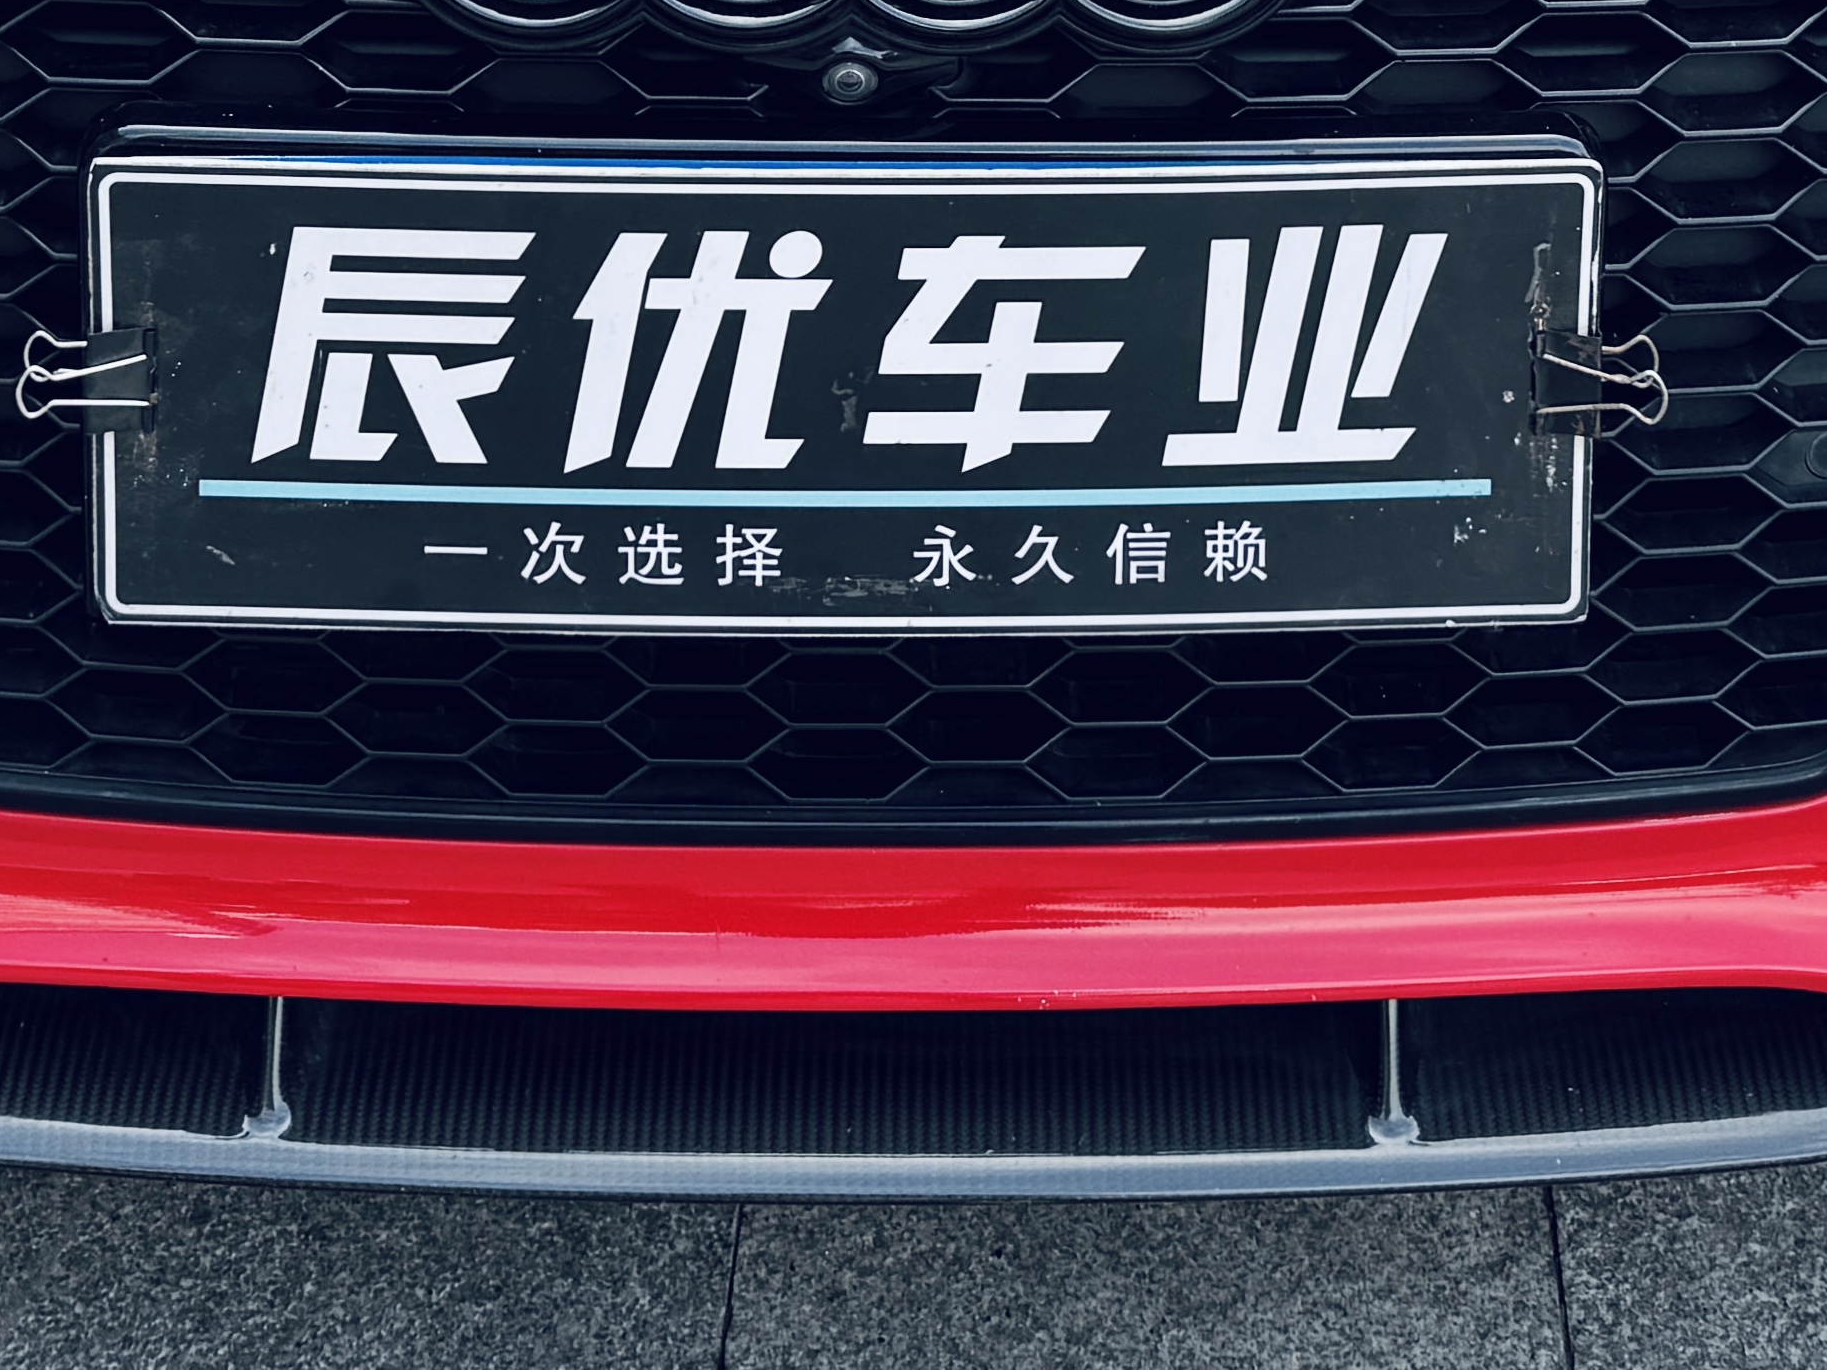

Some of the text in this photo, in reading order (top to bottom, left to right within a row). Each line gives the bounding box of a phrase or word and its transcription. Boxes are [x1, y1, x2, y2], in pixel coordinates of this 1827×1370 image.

[252, 225, 1449, 473] 辰优车业
[422, 519, 1270, 589] 一次选择 永久信赖
